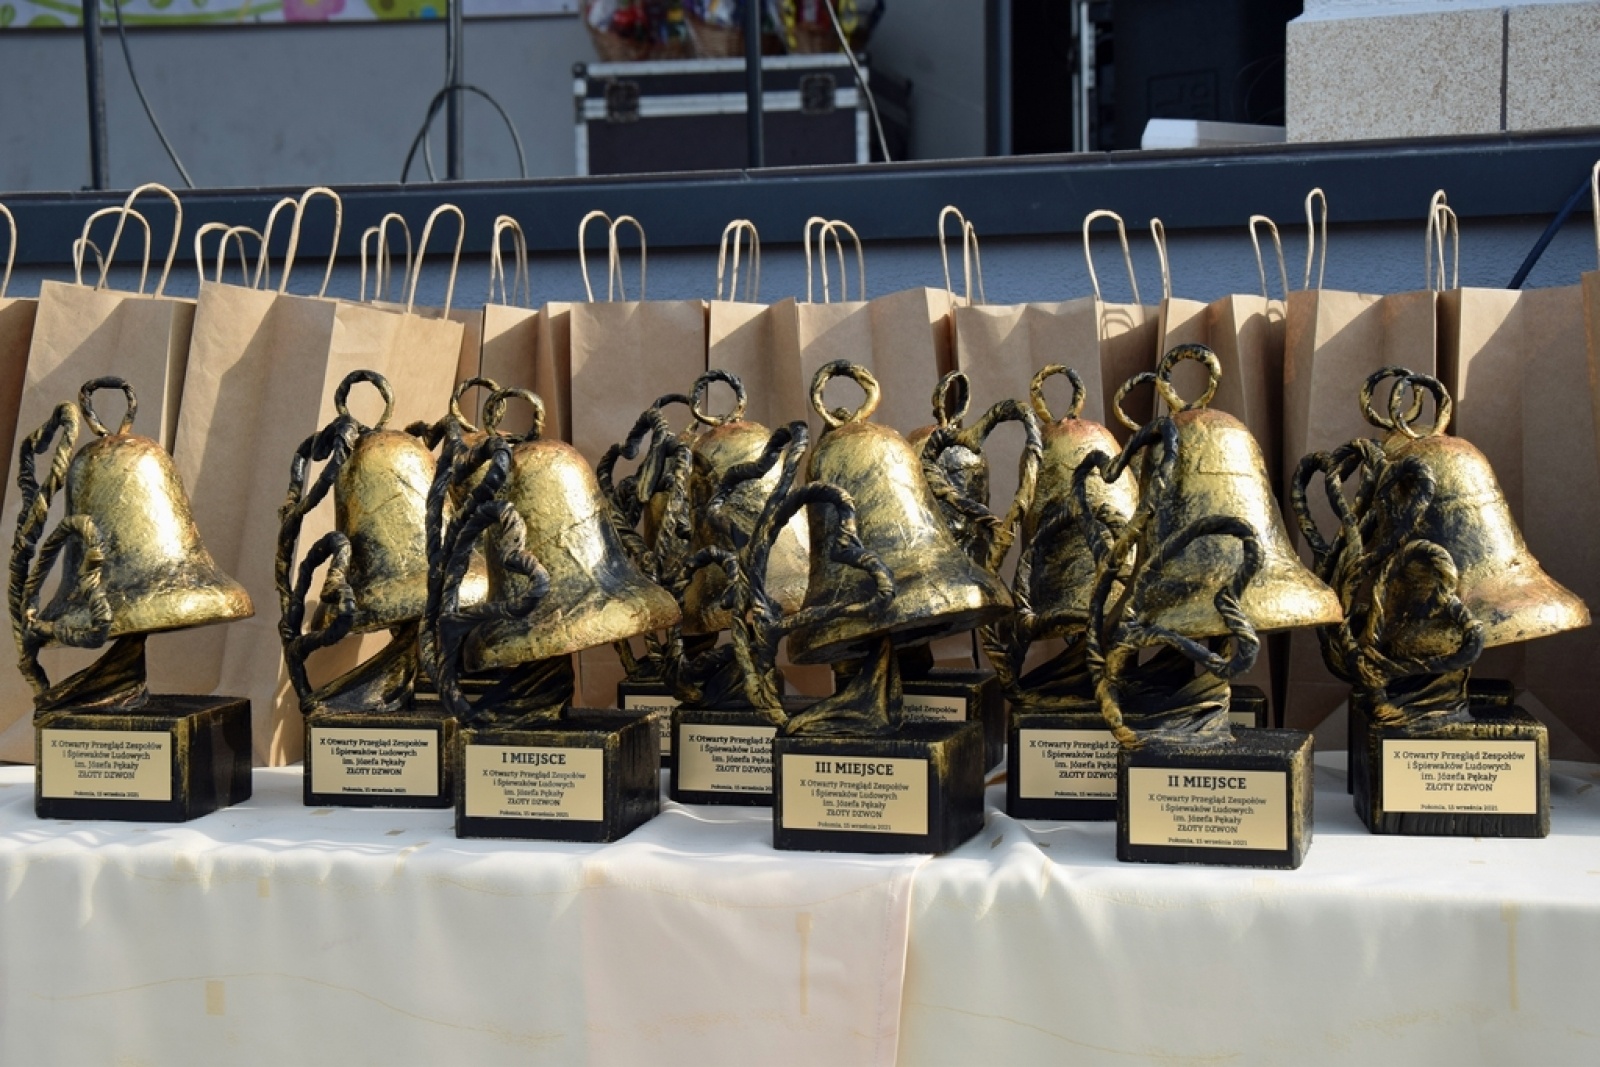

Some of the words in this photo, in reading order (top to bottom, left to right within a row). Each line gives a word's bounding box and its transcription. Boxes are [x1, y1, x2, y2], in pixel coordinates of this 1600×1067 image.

[326, 738, 357, 747] Otwarty
[359, 739, 391, 748] Przegląd
[393, 739, 428, 748] Zespołów
[696, 735, 728, 745] Otwarty
[729, 736, 763, 745] Przegląd
[1038, 740, 1072, 750] Otwarty
[1073, 741, 1108, 750] Przegląd
[59, 740, 89, 749] Otwarty
[92, 741, 123, 750] Przegląd
[126, 742, 162, 751] Zespołów
[111, 752, 150, 761] Ludowych
[379, 749, 417, 757] Ludowych
[1394, 751, 1400, 759] X
[1402, 751, 1439, 761] Otwarty
[1441, 751, 1480, 762] Przegląd
[1482, 752, 1525, 762] Zespołów
[502, 753, 507, 763] I
[510, 753, 566, 766] MIEJSCE
[347, 767, 370, 775] ZŁOTY
[816, 762, 831, 773] III
[835, 762, 894, 776] MIEJSCE
[1465, 762, 1511, 772] Ludowych
[78, 770, 102, 778] ZŁOTY
[489, 770, 518, 778] Otwarty
[520, 771, 550, 779] Przegląd
[552, 772, 586, 780] Zespołów
[1059, 770, 1086, 778] ZŁOTY
[539, 780, 575, 789] Ludowych
[808, 780, 838, 789] Otwarty
[839, 781, 872, 790] Przegląd
[874, 782, 909, 792] Zespołów
[1168, 775, 1178, 787] II
[1183, 776, 1246, 790] MIEJSCE
[1425, 782, 1454, 791] ZŁOTY
[1456, 783, 1492, 791] DZWON
[860, 792, 897, 801] Ludowych
[1156, 794, 1189, 803] Otwarty
[1191, 795, 1226, 804] Przegląd
[1228, 796, 1267, 806] Zespołów
[852, 810, 882, 818] DZWON
[1213, 805, 1254, 815] Ludowych
[1178, 824, 1203, 832] ZŁOTY
[1205, 825, 1238, 833] DZWON
